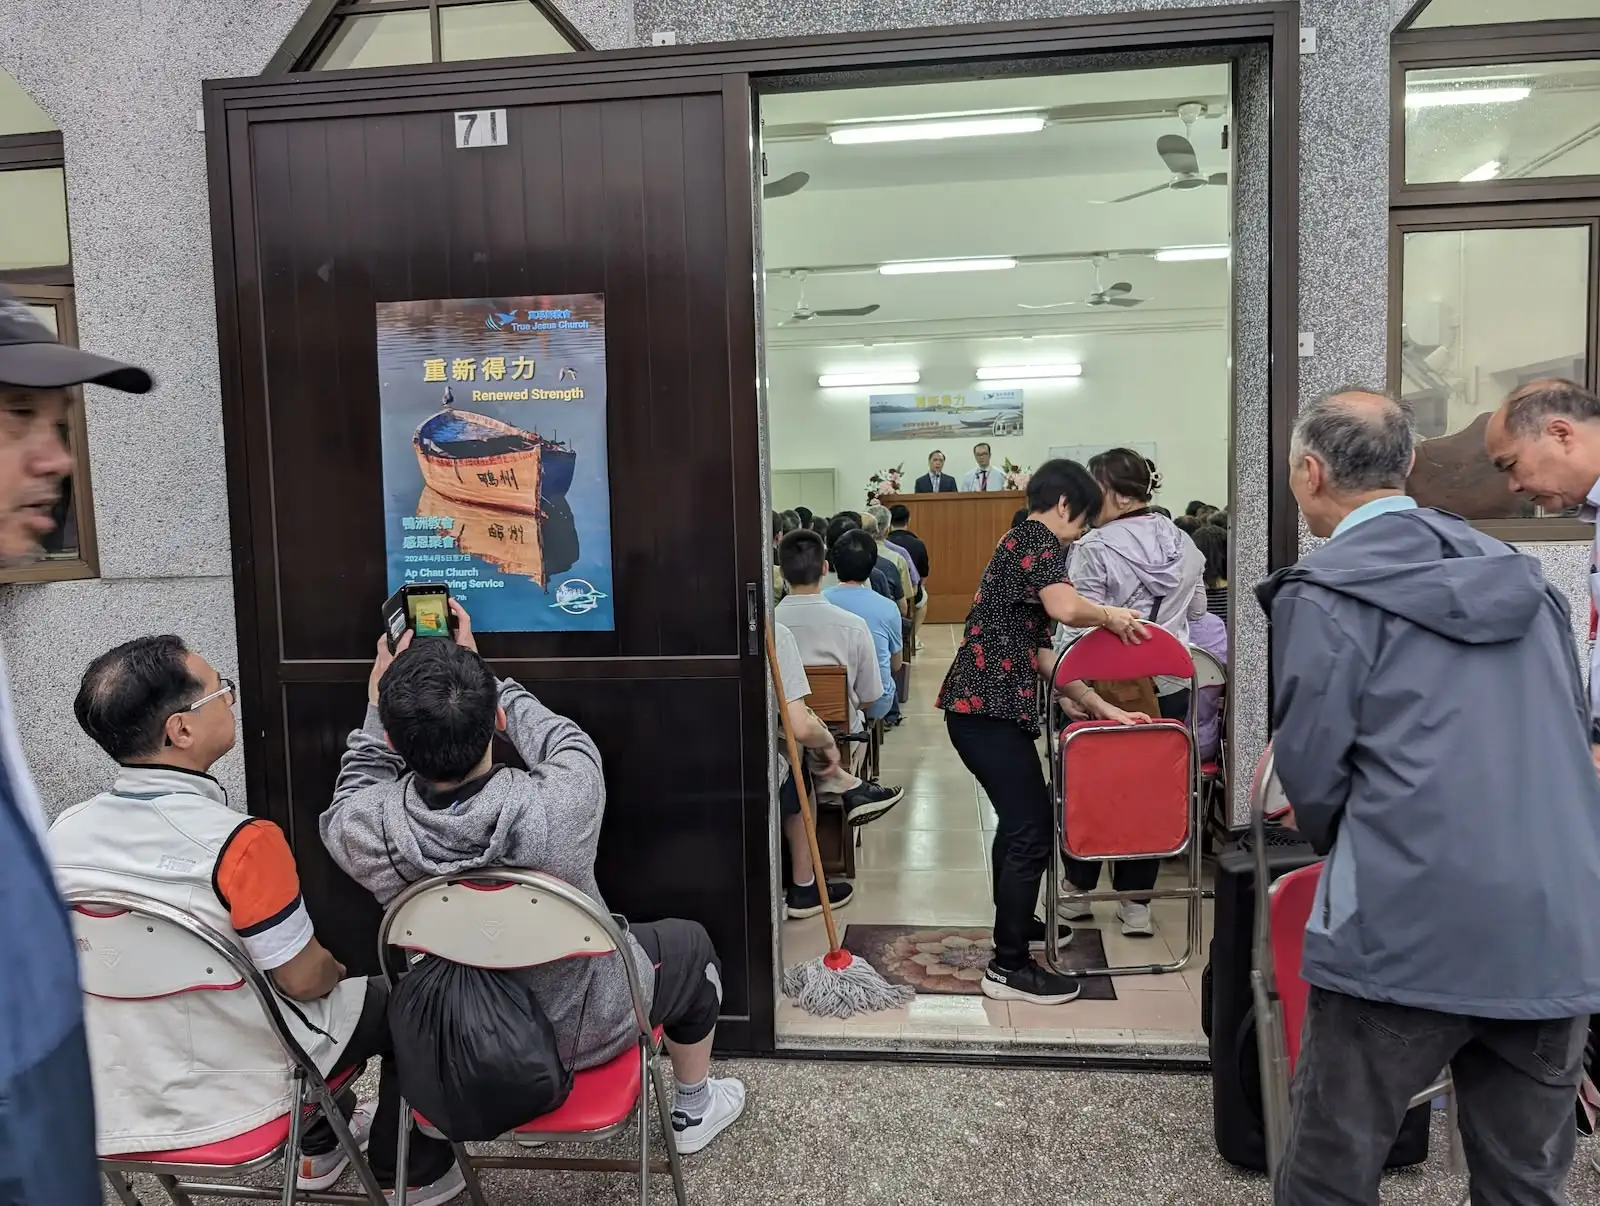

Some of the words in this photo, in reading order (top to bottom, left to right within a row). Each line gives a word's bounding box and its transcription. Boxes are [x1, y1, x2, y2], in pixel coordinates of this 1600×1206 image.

[458, 111, 498, 146] 71
[511, 322, 531, 331] True
[532, 321, 557, 331] Jesus
[558, 319, 589, 329] Church
[423, 356, 535, 382] 重新得力
[472, 388, 529, 402] Renewed
[531, 387, 584, 402] Strength
[404, 568, 418, 579] Ap
[419, 567, 444, 577] Chau
[445, 567, 479, 577] Church
[468, 579, 504, 589] Service
